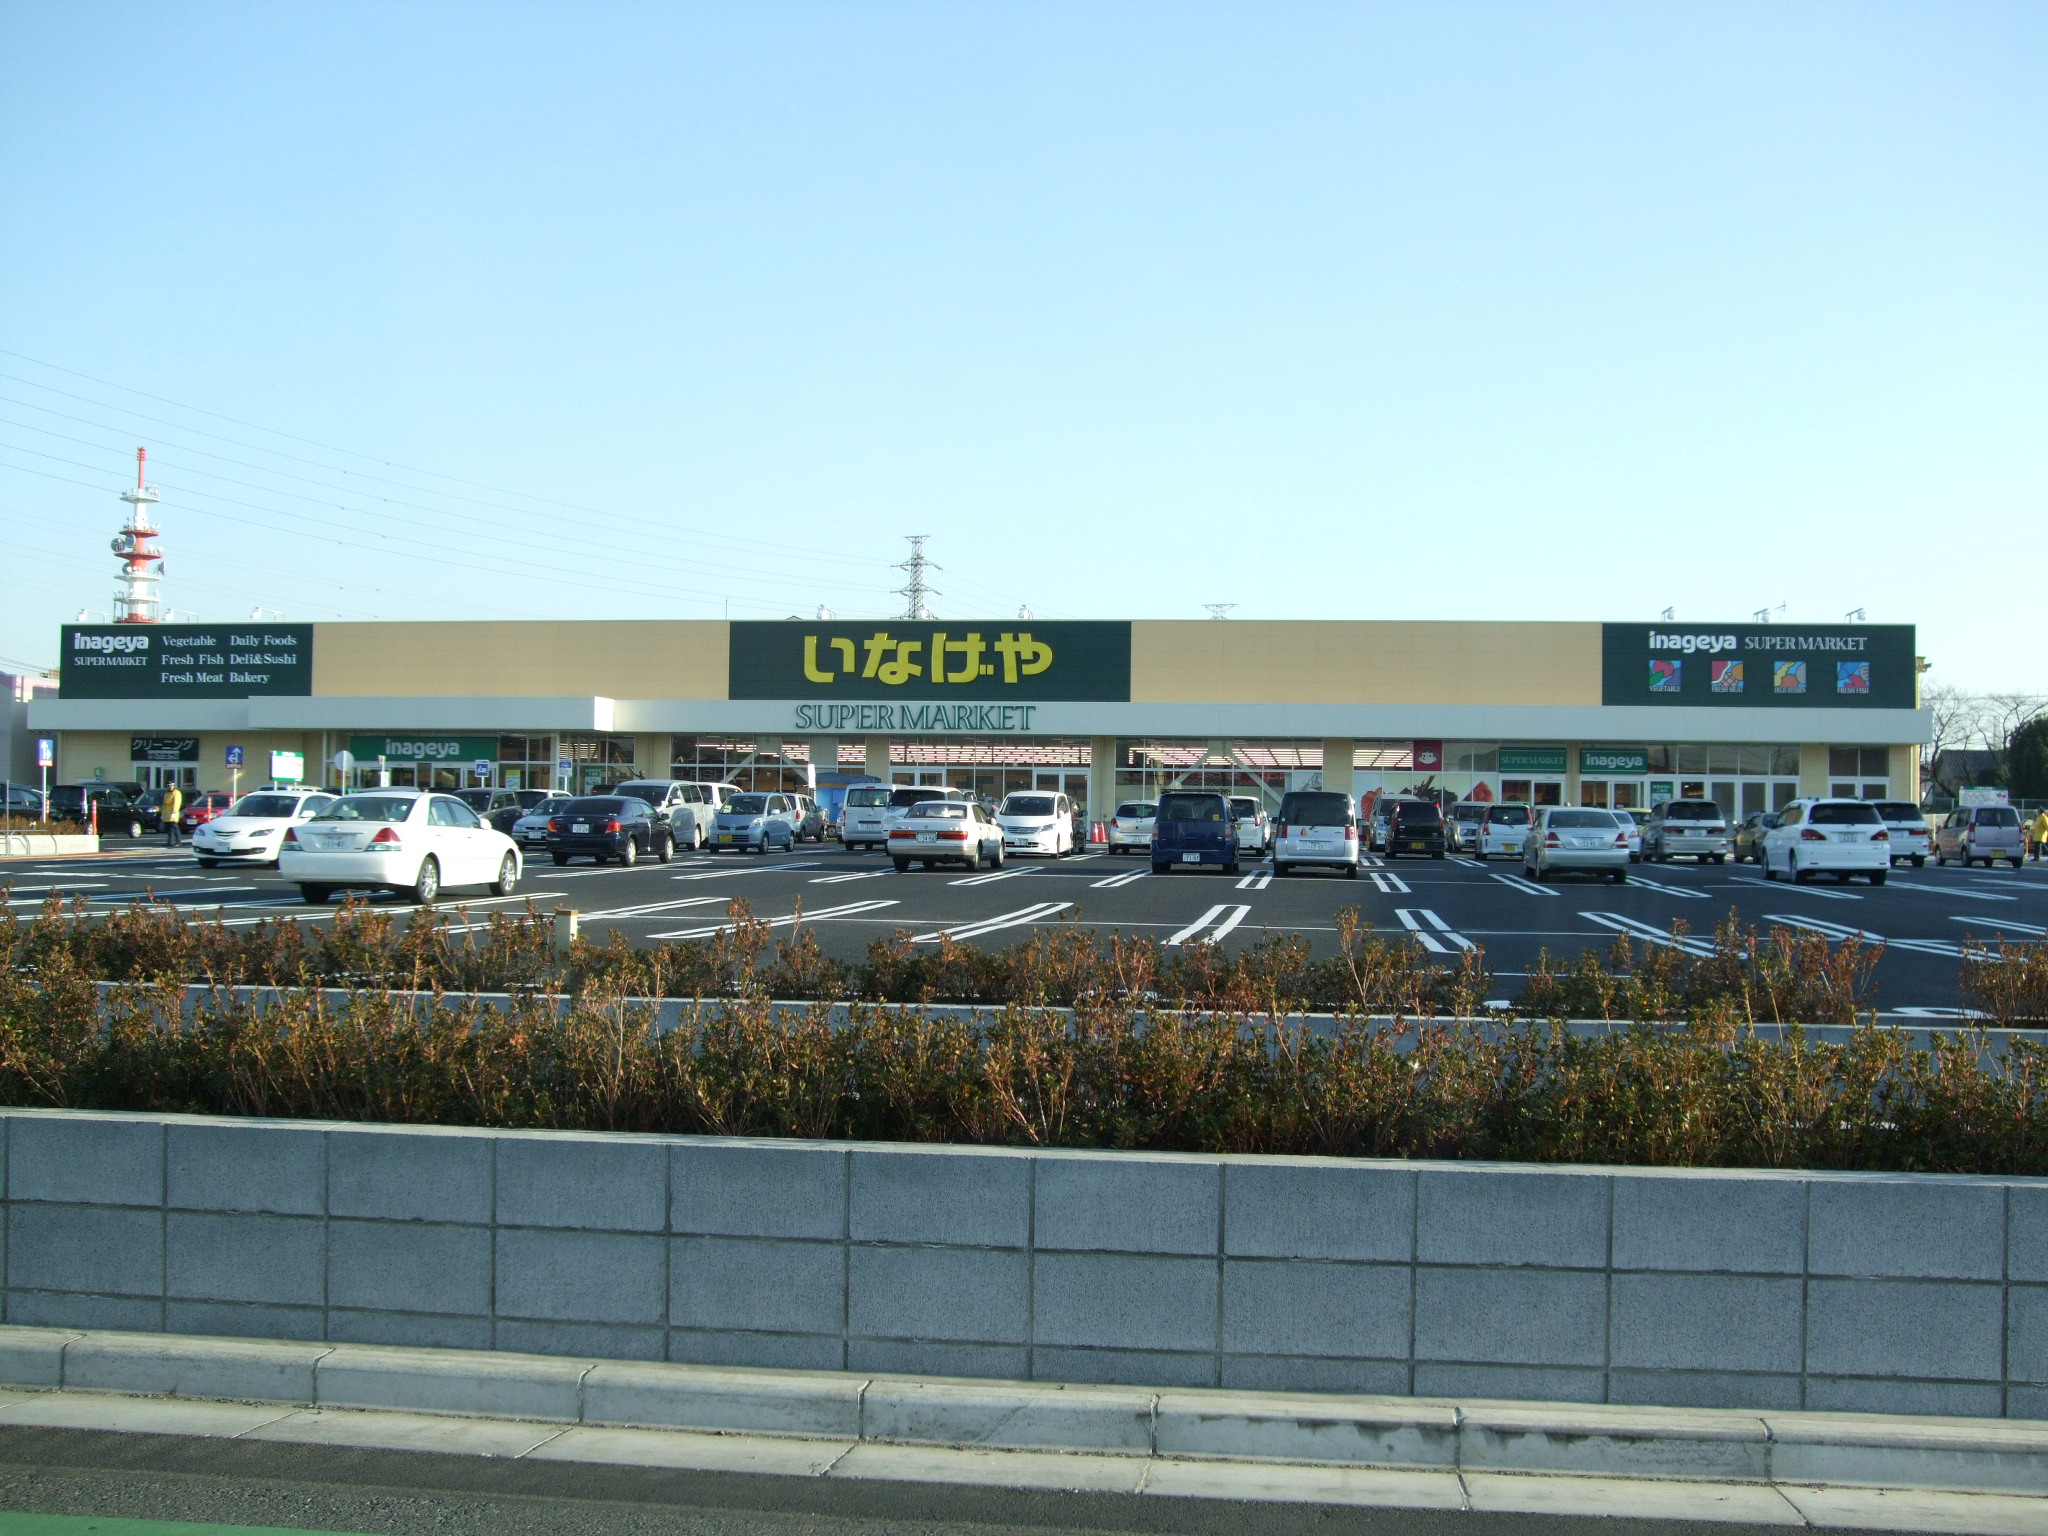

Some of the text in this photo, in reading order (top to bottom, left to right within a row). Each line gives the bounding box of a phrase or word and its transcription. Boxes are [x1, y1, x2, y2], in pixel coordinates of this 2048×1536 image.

[74, 632, 149, 653] inageya
[162, 635, 217, 647] Vegetable
[230, 634, 297, 647] Daily Foods
[1649, 631, 1867, 653] inageya SUPER MARKET
[74, 656, 148, 666] SUPER MARKET
[161, 654, 224, 665] Fresh Fish
[803, 632, 1053, 685] いなげや
[161, 672, 224, 683] Fresh Meat
[230, 671, 270, 684] Bakery
[1649, 685, 1681, 693] VEGETABLE
[795, 704, 1036, 731] SUPER MARKET
[132, 739, 195, 750] クリーニング
[385, 738, 460, 758] inageya
[1586, 753, 1643, 768] inageya
